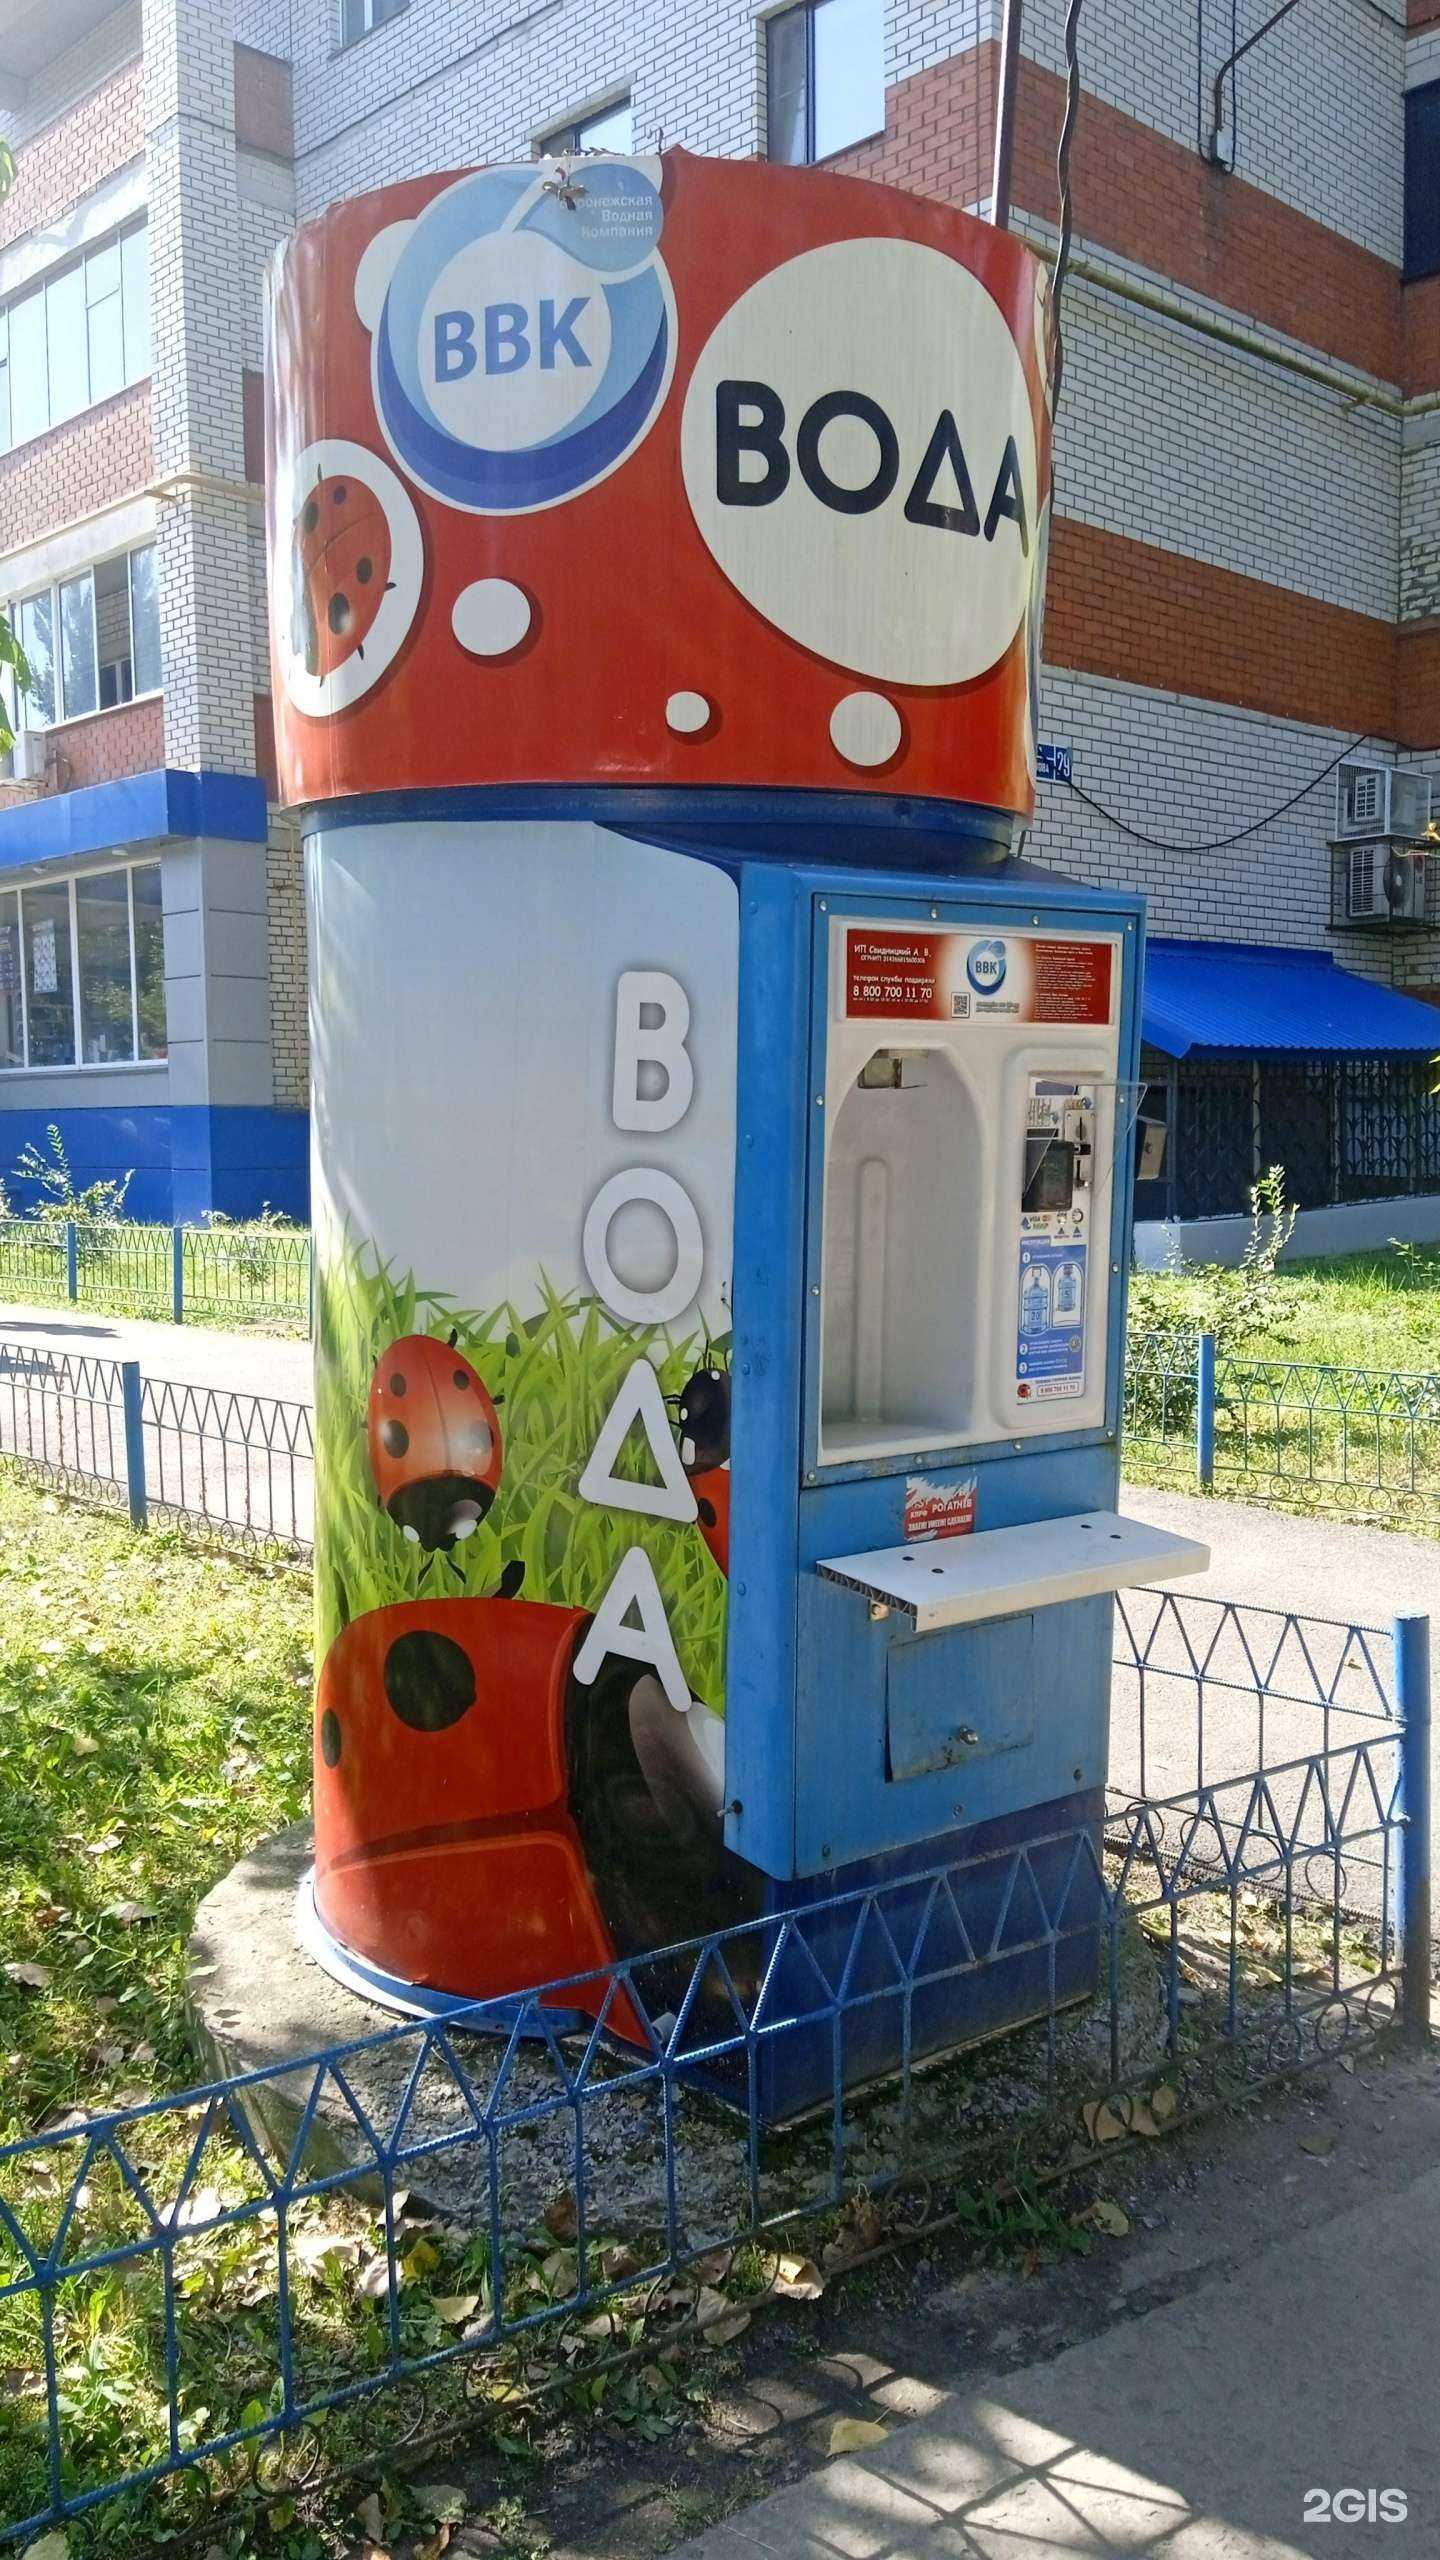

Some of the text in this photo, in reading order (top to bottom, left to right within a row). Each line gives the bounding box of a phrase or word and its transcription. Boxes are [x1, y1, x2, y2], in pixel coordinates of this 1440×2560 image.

[601, 209, 653, 223] Водная
[582, 225, 653, 239] Компания
[434, 296, 593, 383] ВВК
[716, 379, 1029, 559] ВОДА
[854, 944, 867, 954] ИП
[975, 961, 997, 974] ВВК
[853, 975, 879, 984] телефон
[880, 975, 903, 985] службы
[853, 985, 933, 999] 8 800 700 11 70
[573, 971, 704, 1713] ВОДА
